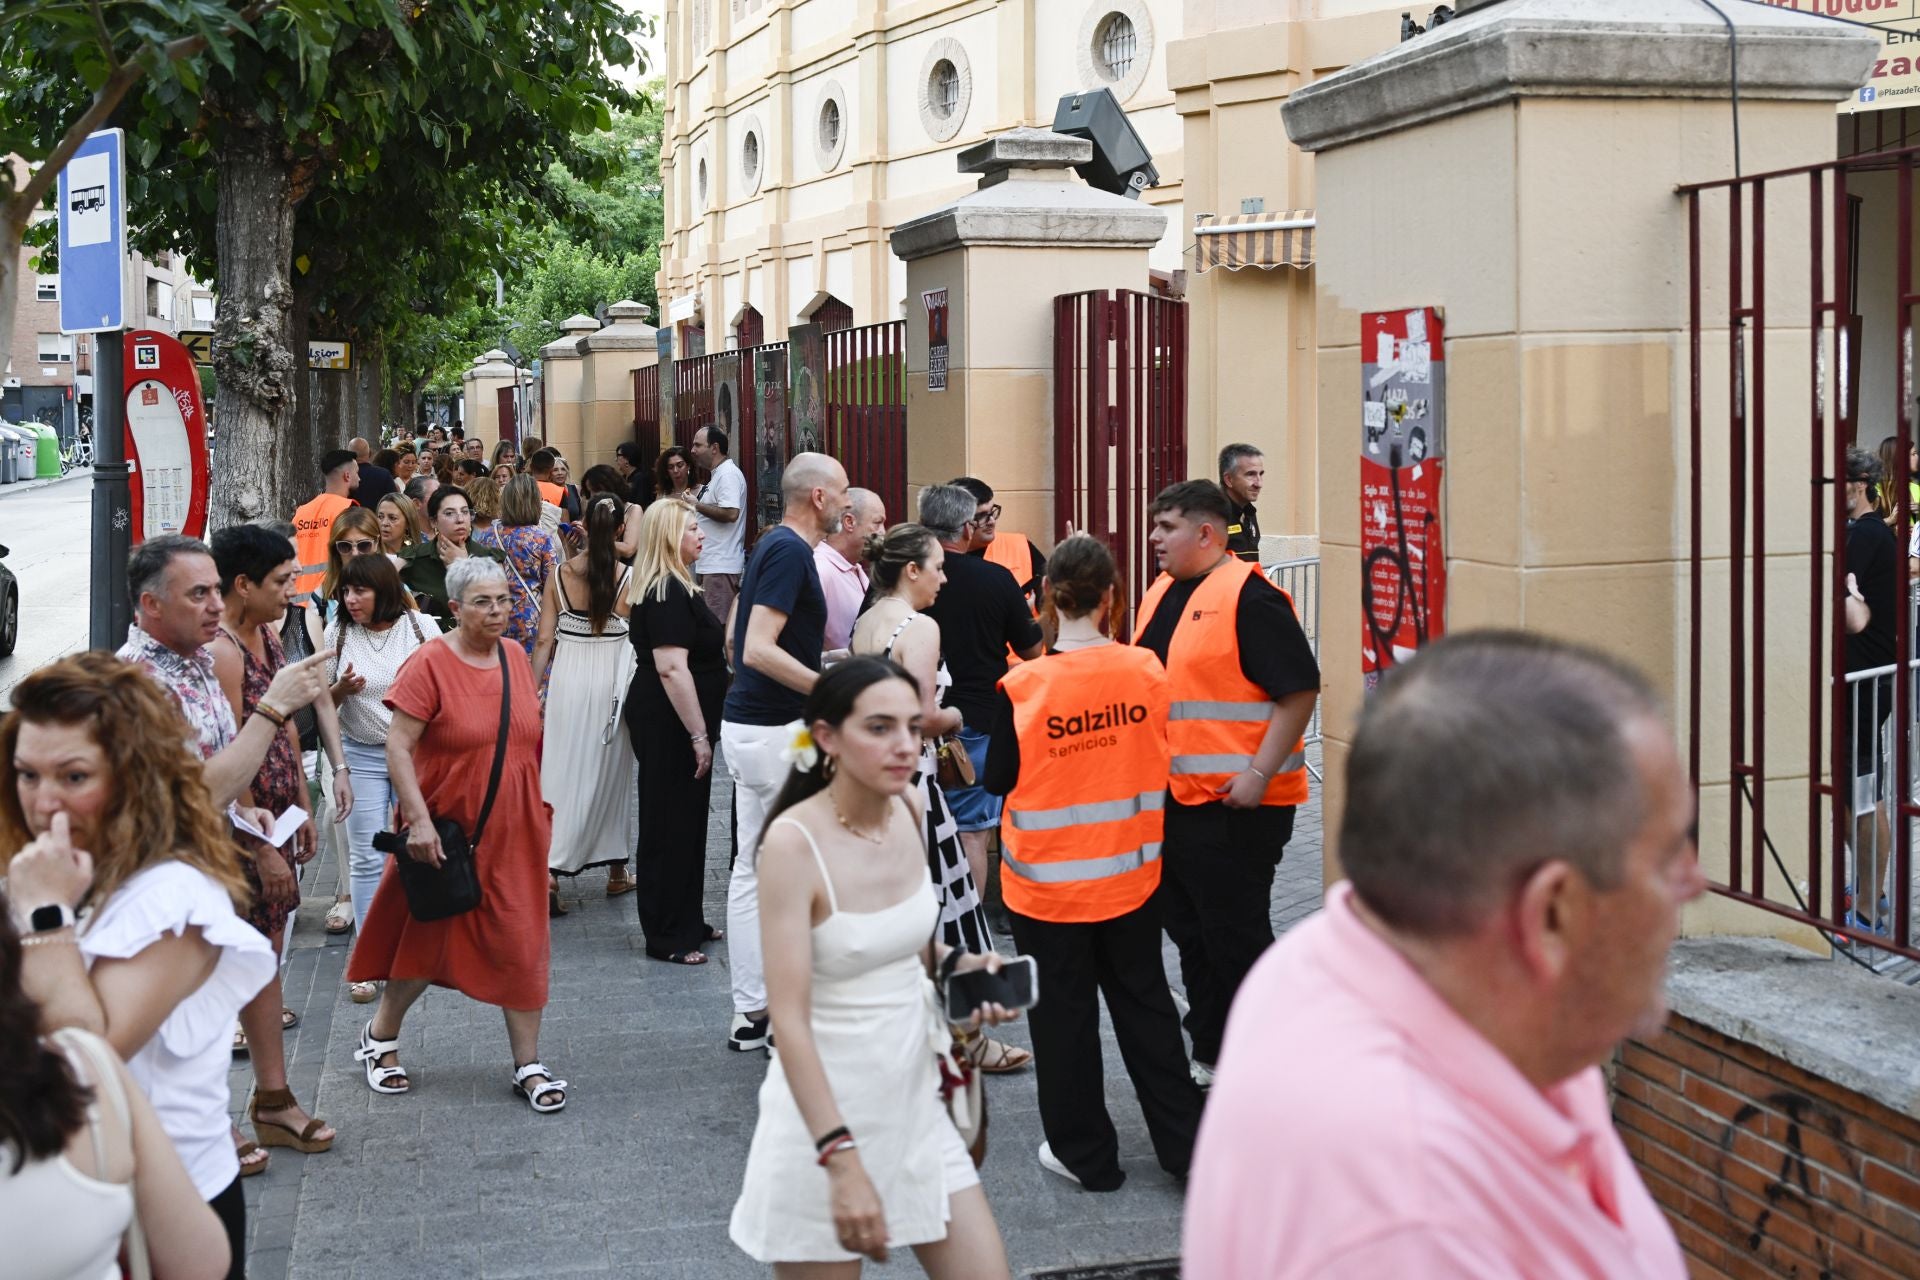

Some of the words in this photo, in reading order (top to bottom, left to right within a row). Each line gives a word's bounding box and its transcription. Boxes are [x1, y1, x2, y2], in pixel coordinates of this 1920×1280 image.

[307, 348, 339, 358] lsior
[1047, 702, 1147, 740] Salzillo
[1049, 735, 1117, 758] servicios
